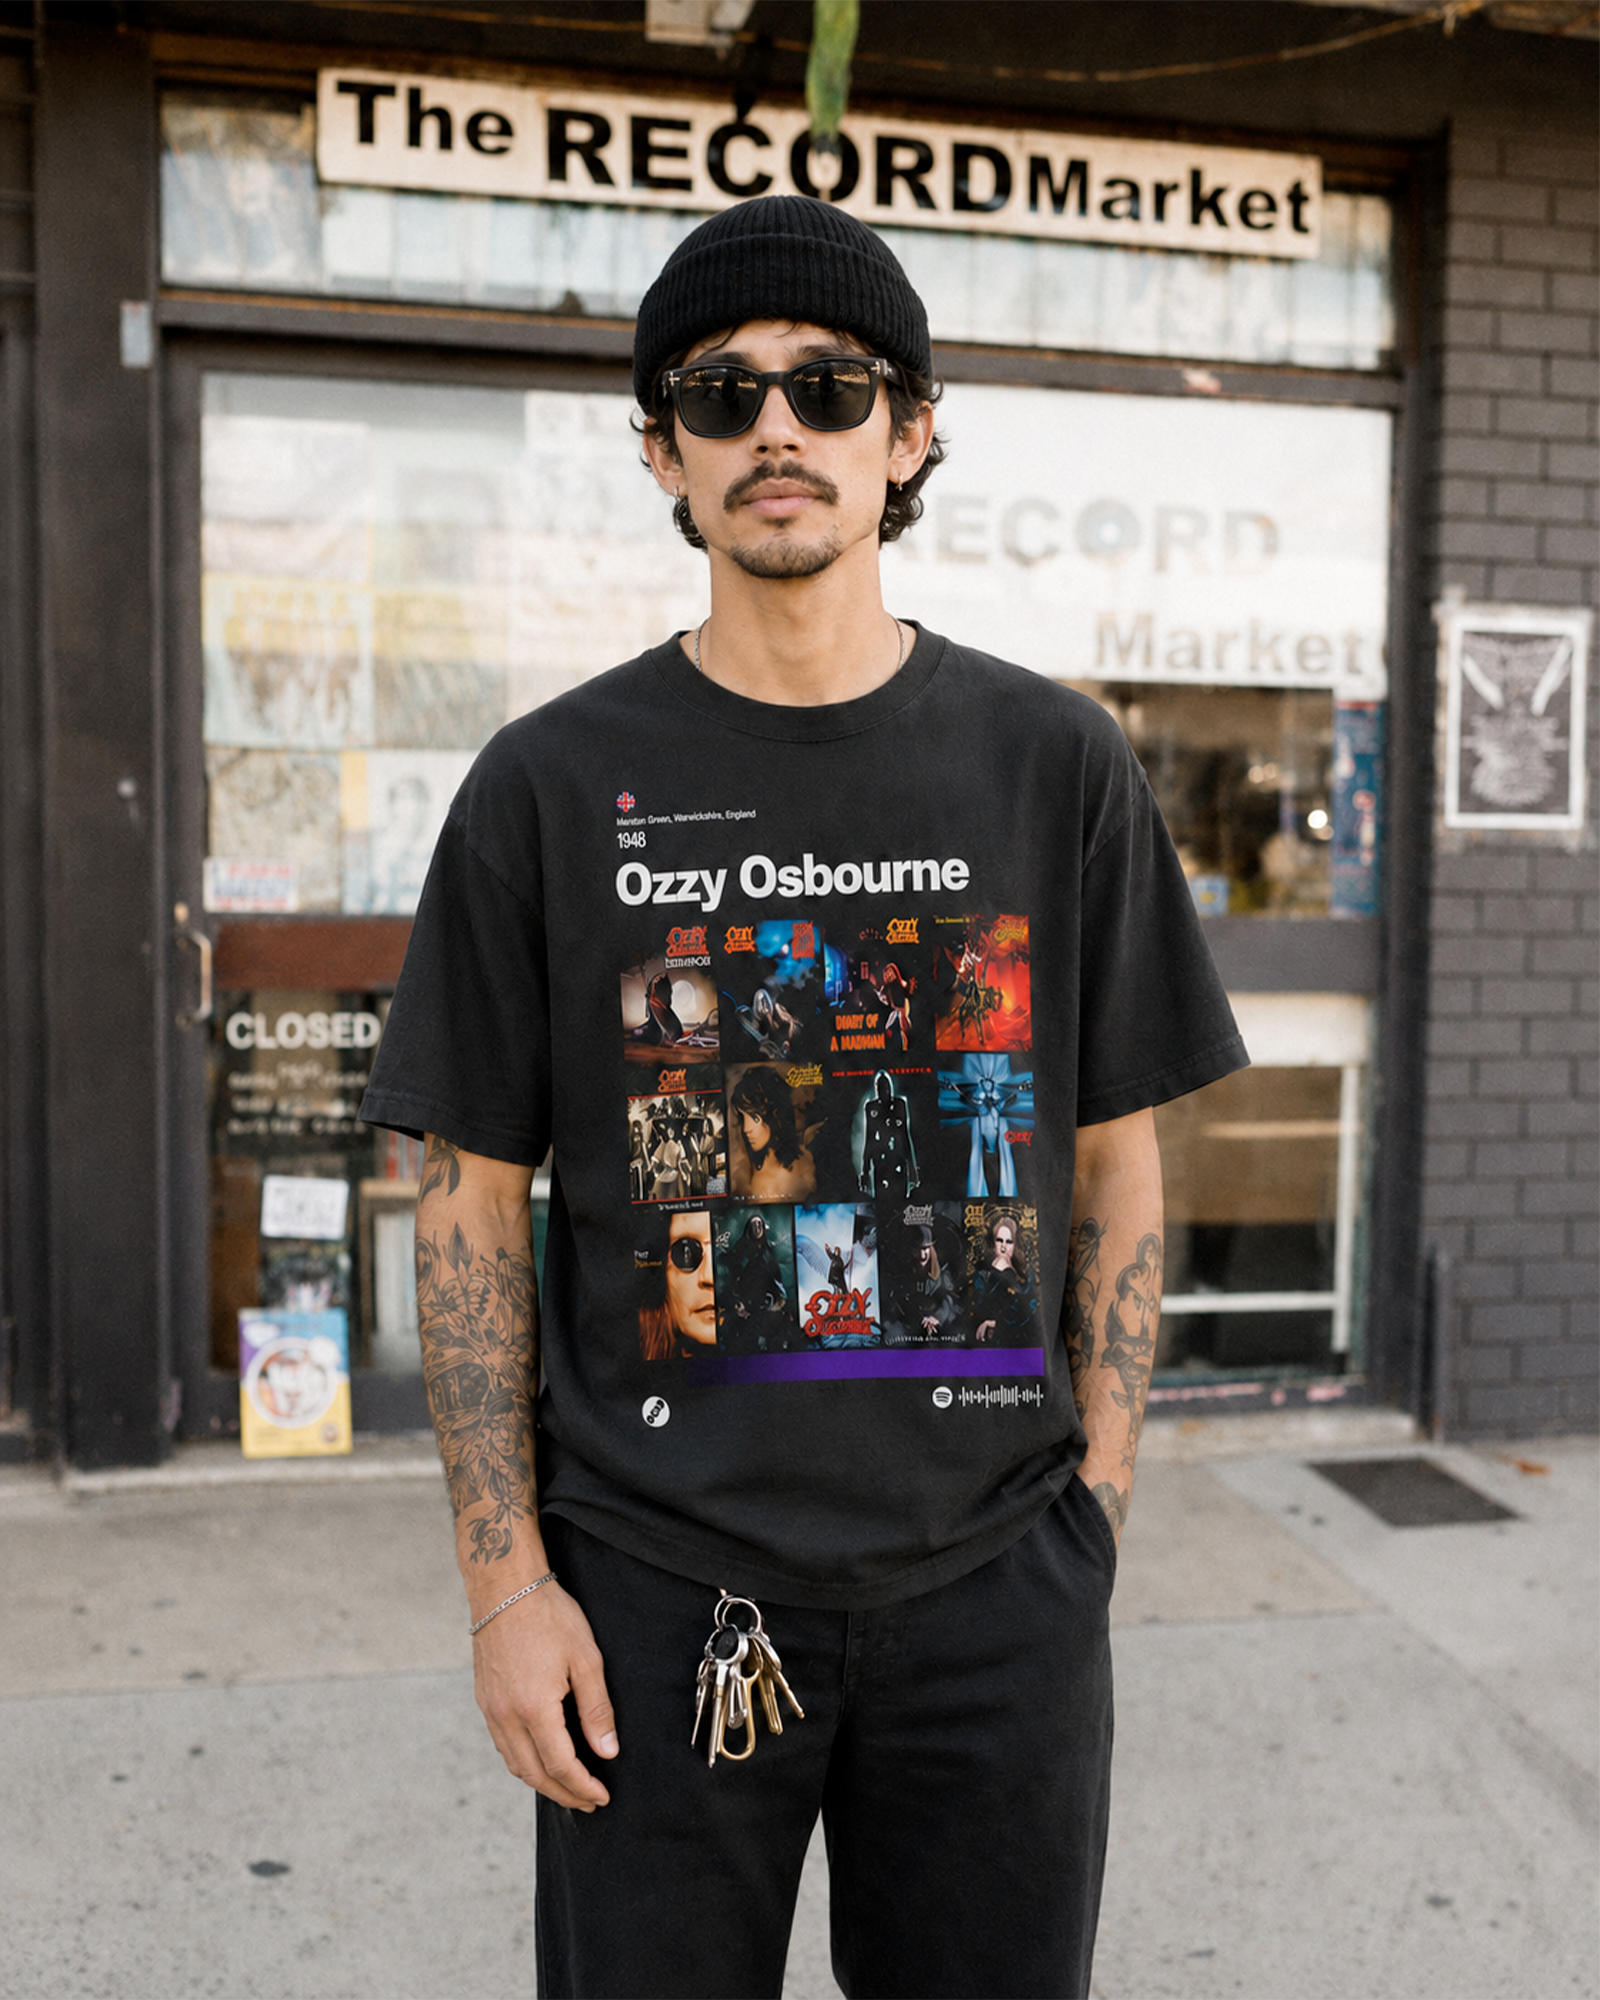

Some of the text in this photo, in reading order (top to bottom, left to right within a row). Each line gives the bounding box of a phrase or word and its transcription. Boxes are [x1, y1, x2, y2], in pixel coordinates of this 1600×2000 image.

[335, 79, 514, 155] The
[898, 492, 1281, 577] ECORD
[1095, 610, 1366, 676] Market
[616, 831, 647, 849] 1948
[725, 808, 757, 821] England
[615, 853, 971, 912] Ozzy Osbourne
[226, 1011, 382, 1050] CLOSED
